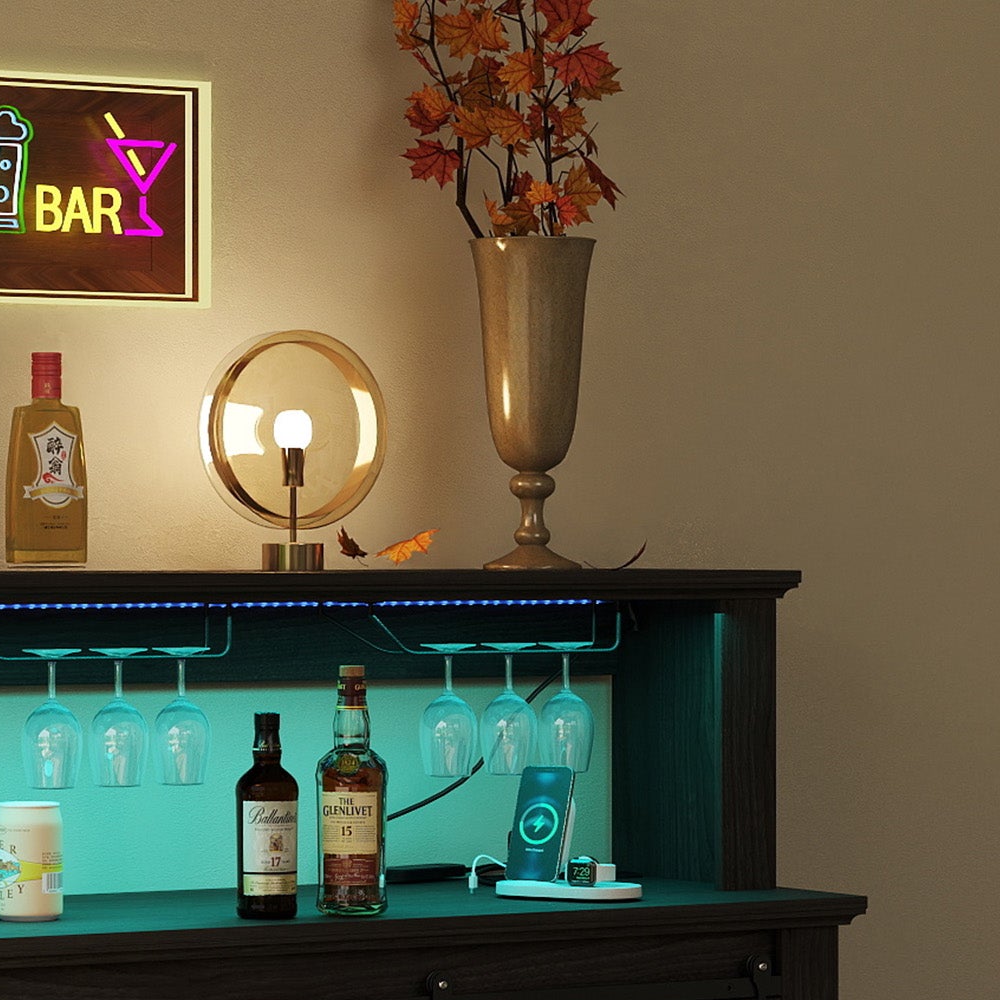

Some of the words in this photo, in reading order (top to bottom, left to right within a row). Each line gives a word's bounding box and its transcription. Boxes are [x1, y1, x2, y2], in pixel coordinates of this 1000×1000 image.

[35, 184, 123, 235] BAR
[338, 797, 354, 805] THE
[323, 805, 372, 817] GLENLIVET
[341, 826, 352, 836] 15
[271, 856, 281, 867] 17
[572, 866, 591, 877] 7:29
